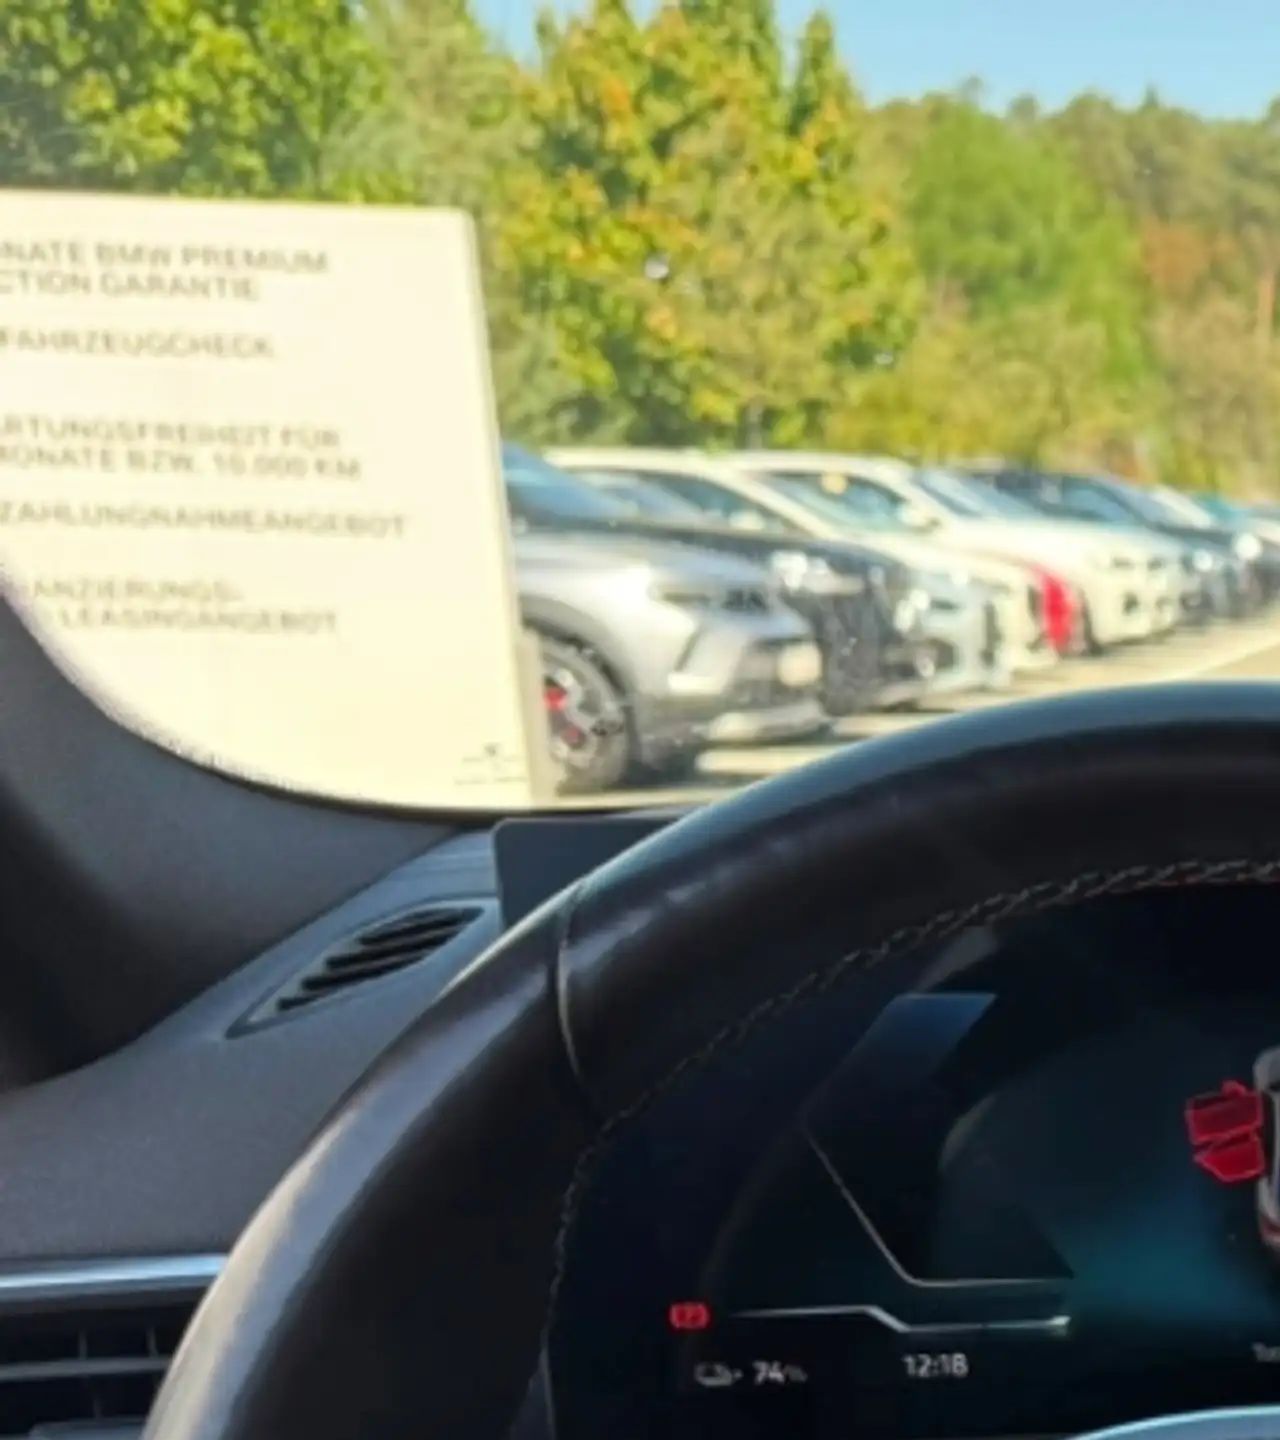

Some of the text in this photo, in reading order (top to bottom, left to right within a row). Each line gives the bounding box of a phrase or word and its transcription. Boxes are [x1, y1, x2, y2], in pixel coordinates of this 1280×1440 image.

[95, 242, 172, 267] BMW
[181, 245, 330, 274] PREMIUM
[100, 272, 260, 301] GARANTIE
[902, 1353, 969, 1378] 12:18
